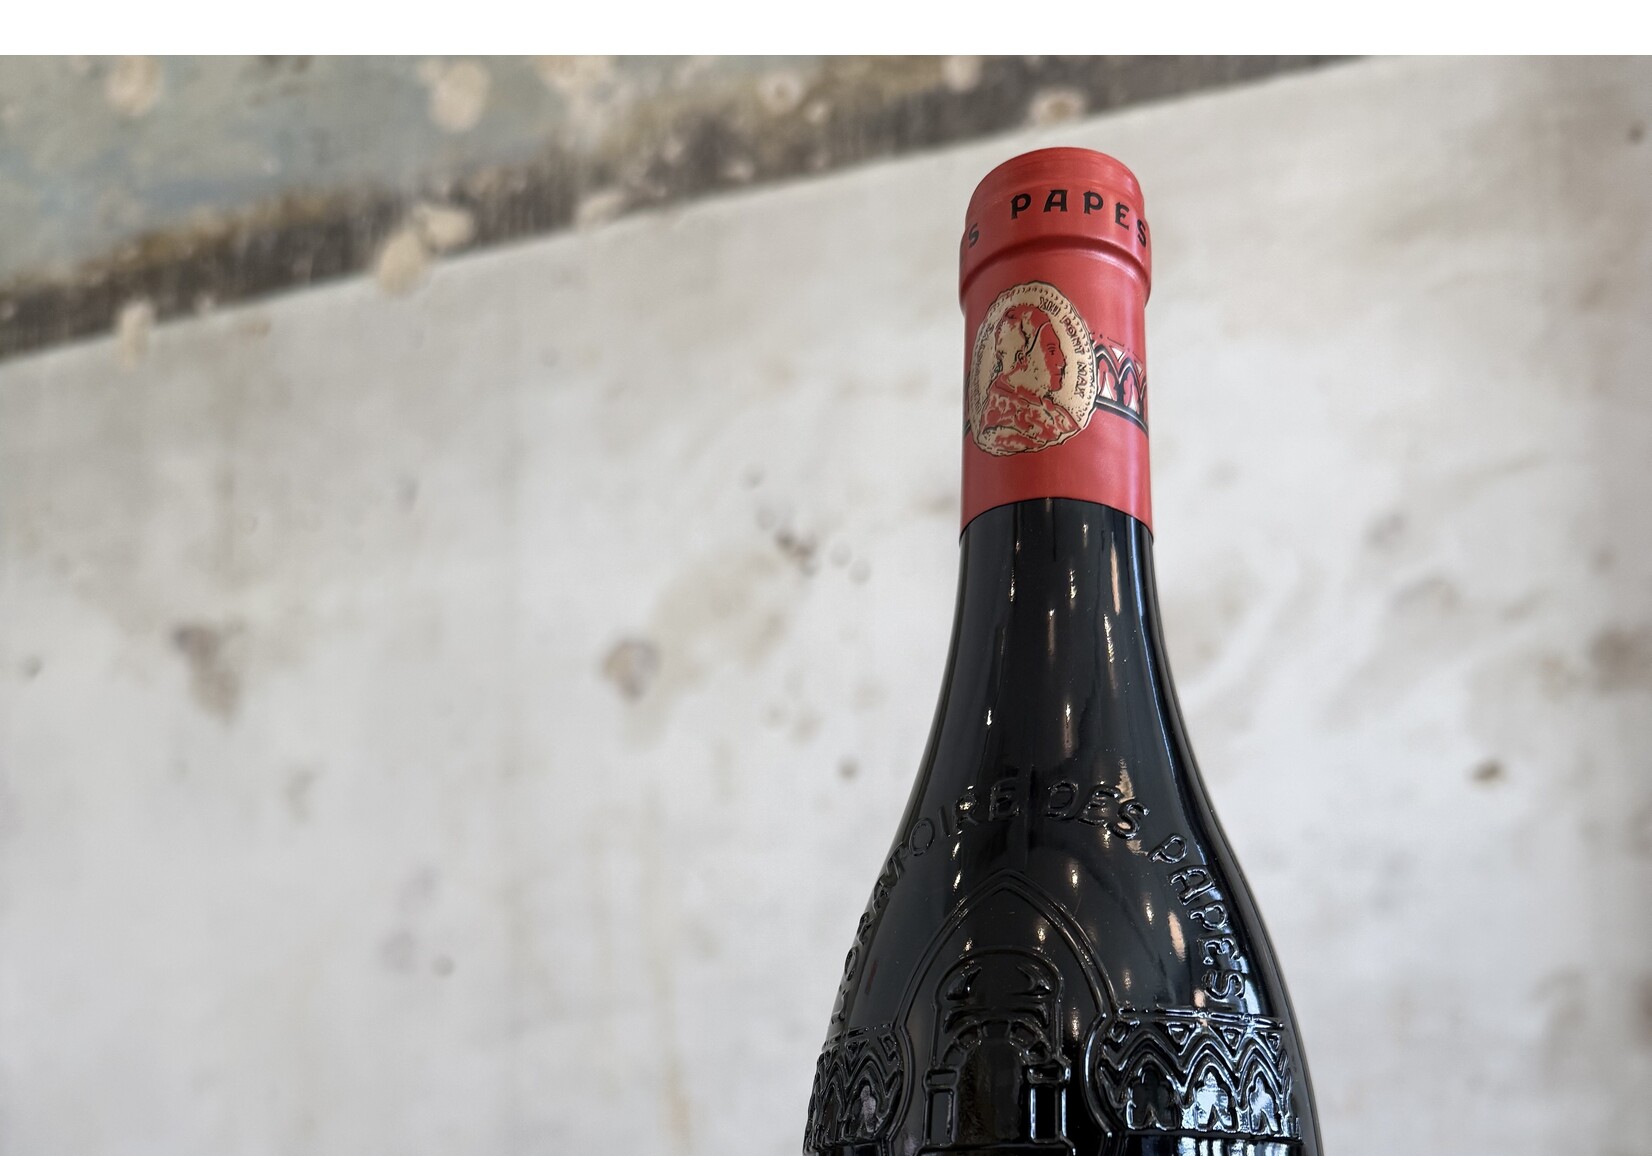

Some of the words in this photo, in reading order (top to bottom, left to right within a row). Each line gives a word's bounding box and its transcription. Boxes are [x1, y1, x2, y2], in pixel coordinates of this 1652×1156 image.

[1010, 189, 1147, 247] PAPES
[1046, 780, 1150, 840] DES
[1149, 833, 1246, 1003] PAPES
